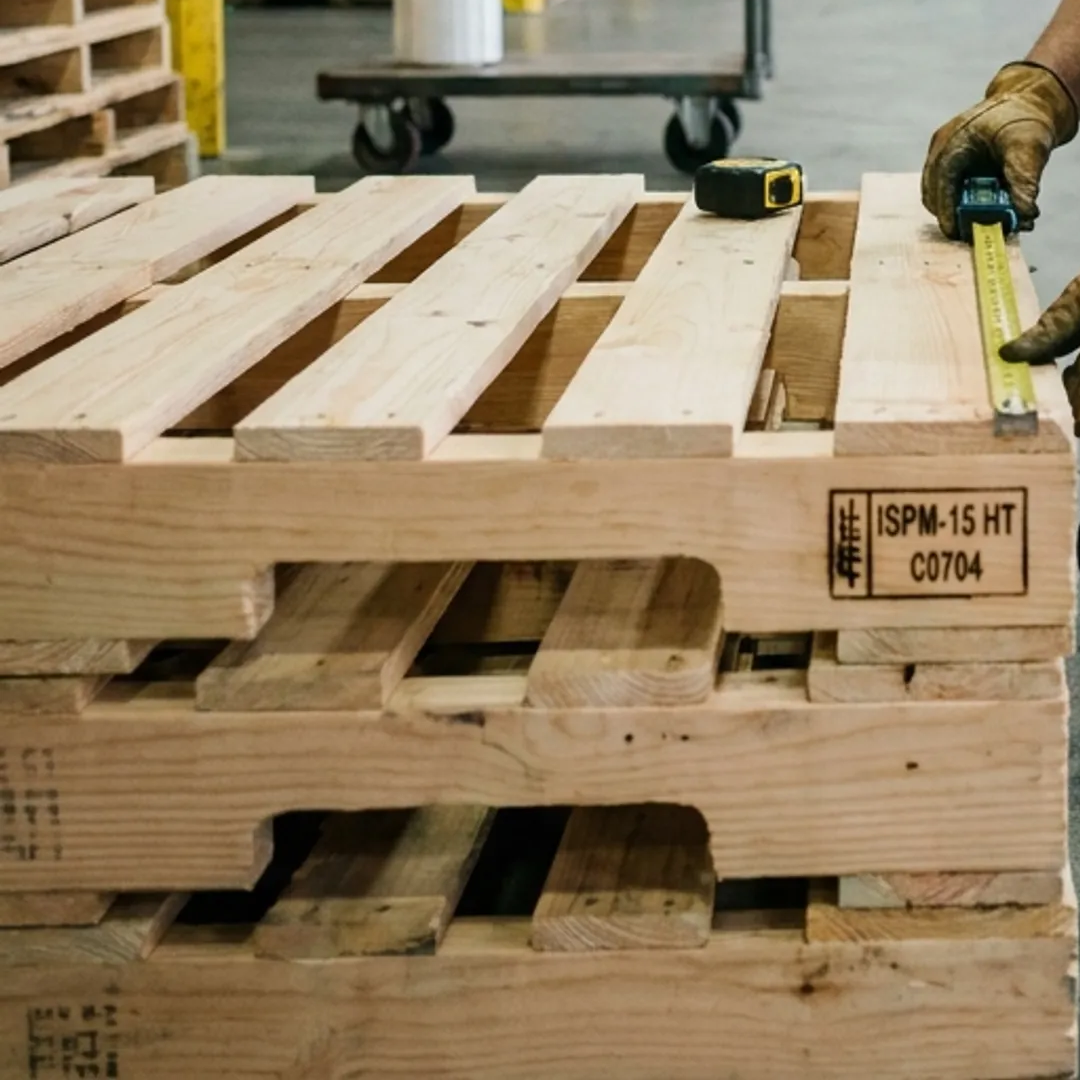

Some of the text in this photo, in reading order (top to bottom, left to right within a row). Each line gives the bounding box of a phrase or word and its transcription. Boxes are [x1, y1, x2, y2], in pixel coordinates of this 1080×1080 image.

[877, 503, 1016, 537] ISPM-15 HT
[910, 550, 983, 583] C0704
